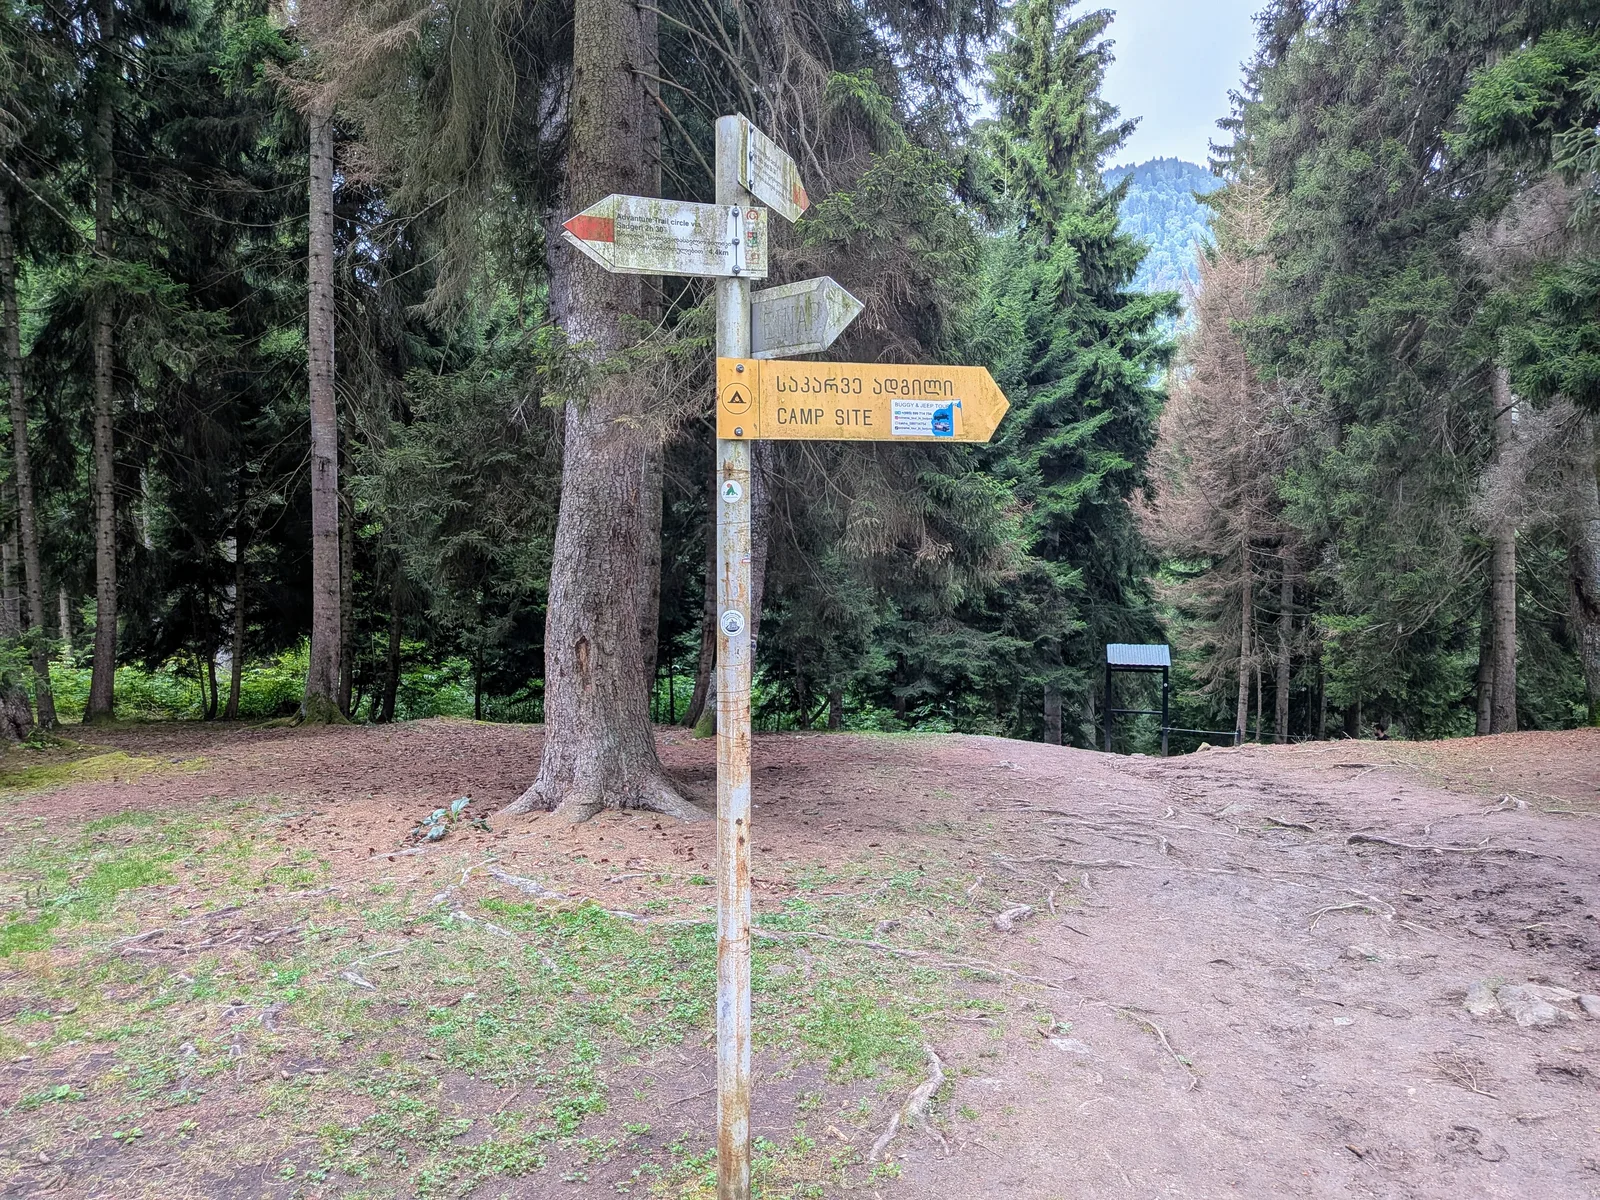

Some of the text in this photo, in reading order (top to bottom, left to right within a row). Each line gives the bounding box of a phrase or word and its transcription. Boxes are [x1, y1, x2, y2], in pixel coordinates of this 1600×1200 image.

[670, 218, 690, 227] circle
[776, 375, 954, 397] საკარვე ადგილი
[776, 407, 873, 426] CAMP SITE
